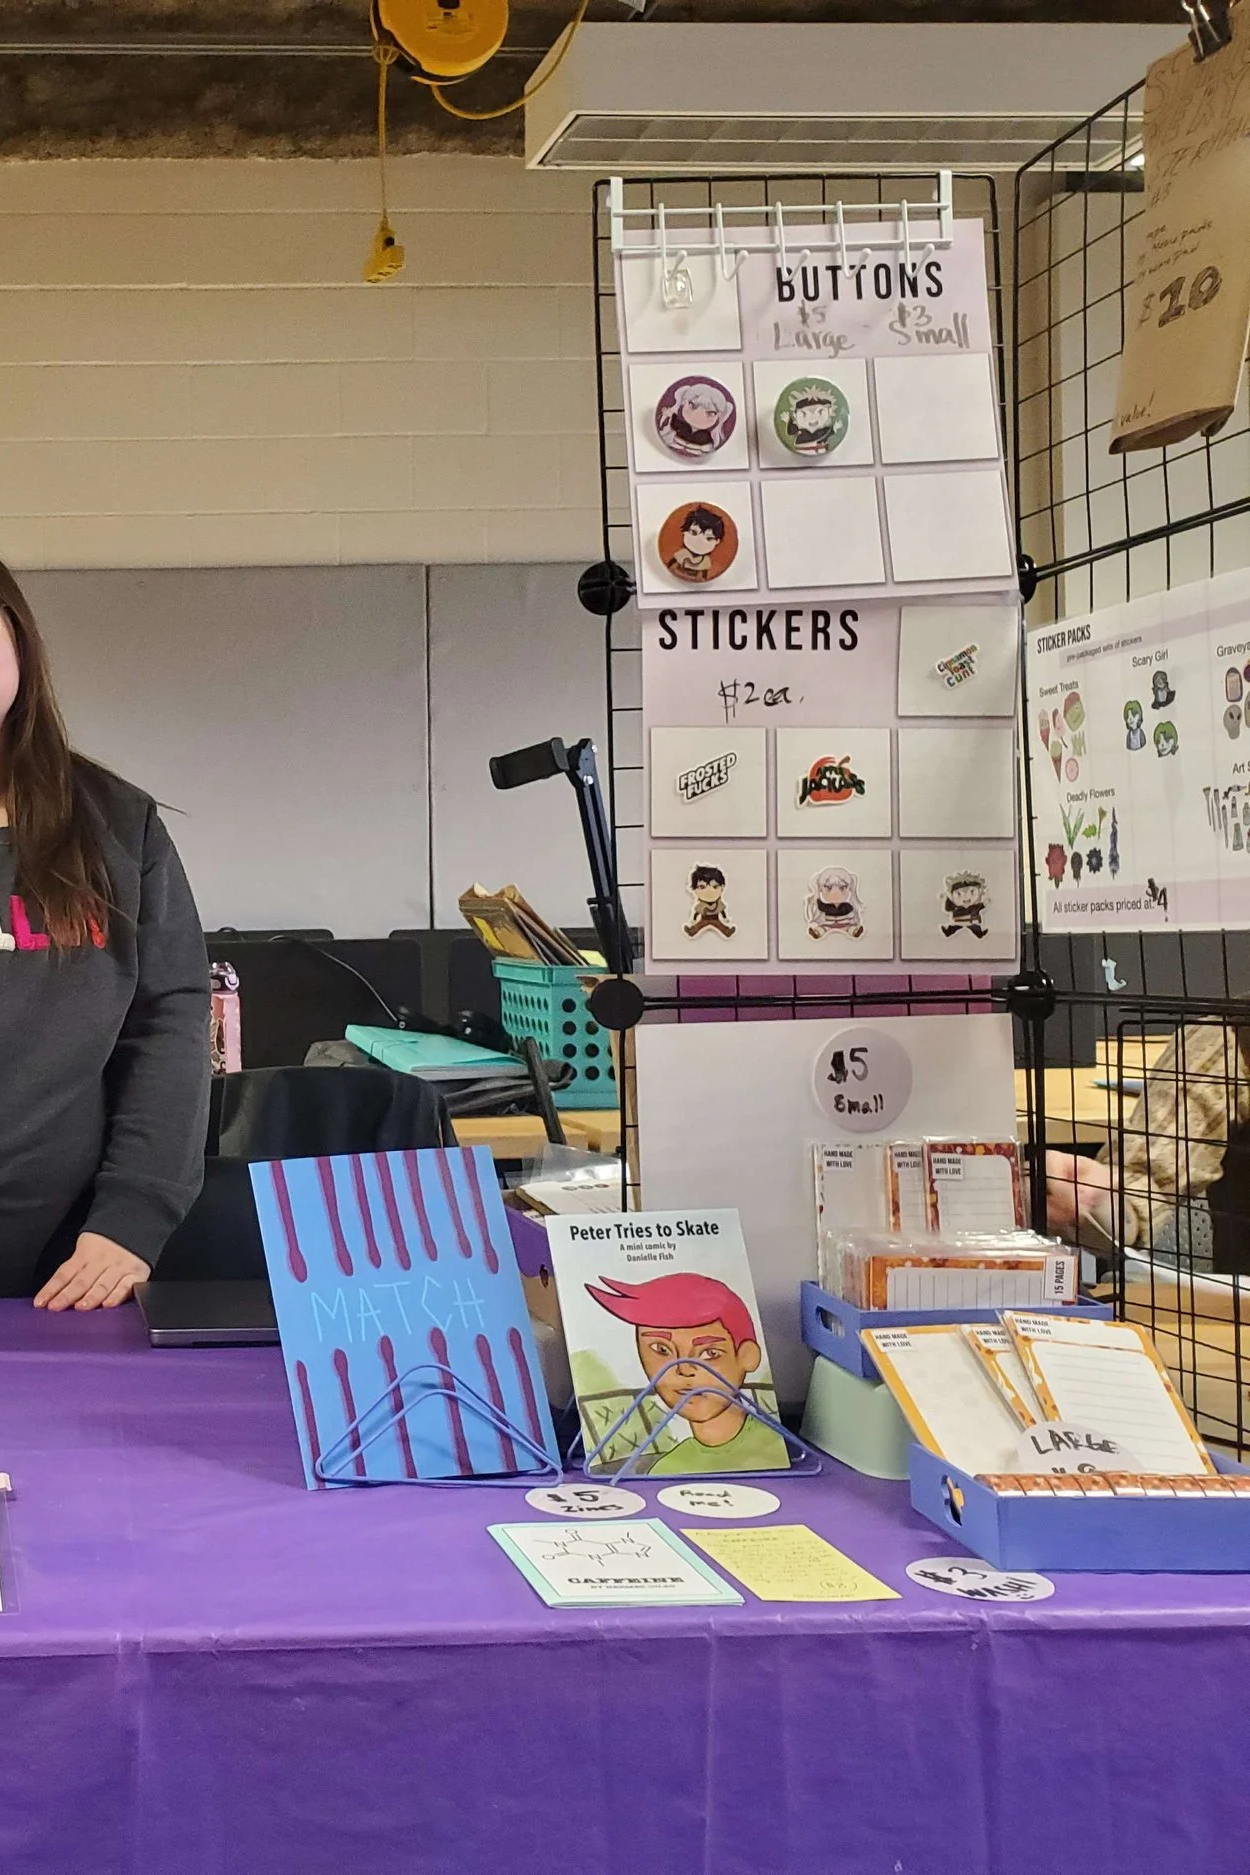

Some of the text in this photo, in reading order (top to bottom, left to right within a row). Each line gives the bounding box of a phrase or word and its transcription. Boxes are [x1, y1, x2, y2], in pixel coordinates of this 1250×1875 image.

[776, 261, 944, 302] BUTTONS
[1138, 265, 1223, 329] $10
[773, 312, 970, 358] Large Small
[658, 608, 860, 651] STICKERS
[1037, 624, 1091, 654] STICKER PACKS
[937, 644, 978, 673] Cinnamon
[1132, 648, 1169, 668] Scary Girl
[1039, 679, 1079, 698] Sweet Treats
[679, 752, 736, 790] FROSTED
[1232, 762, 1245, 774] Art
[687, 769, 728, 799] FUCKS
[1066, 787, 1115, 804] Deadly Flowers
[1053, 902, 1063, 913] All
[1064, 900, 1089, 913] sticker
[1090, 899, 1115, 914] packs
[1116, 898, 1142, 914] priced
[833, 1093, 884, 1115] Small
[824, 1150, 853, 1158] HAND MADE
[933, 1157, 947, 1165] HAND
[570, 1219, 720, 1241] Peter Tries to Skate
[619, 1241, 677, 1251] A mini comic by
[626, 1252, 674, 1262] Danielle Fish
[1054, 1260, 1065, 1294] 15 PAGES
[312, 1275, 486, 1343] MATCH
[567, 1576, 685, 1584] CAFFEINE
